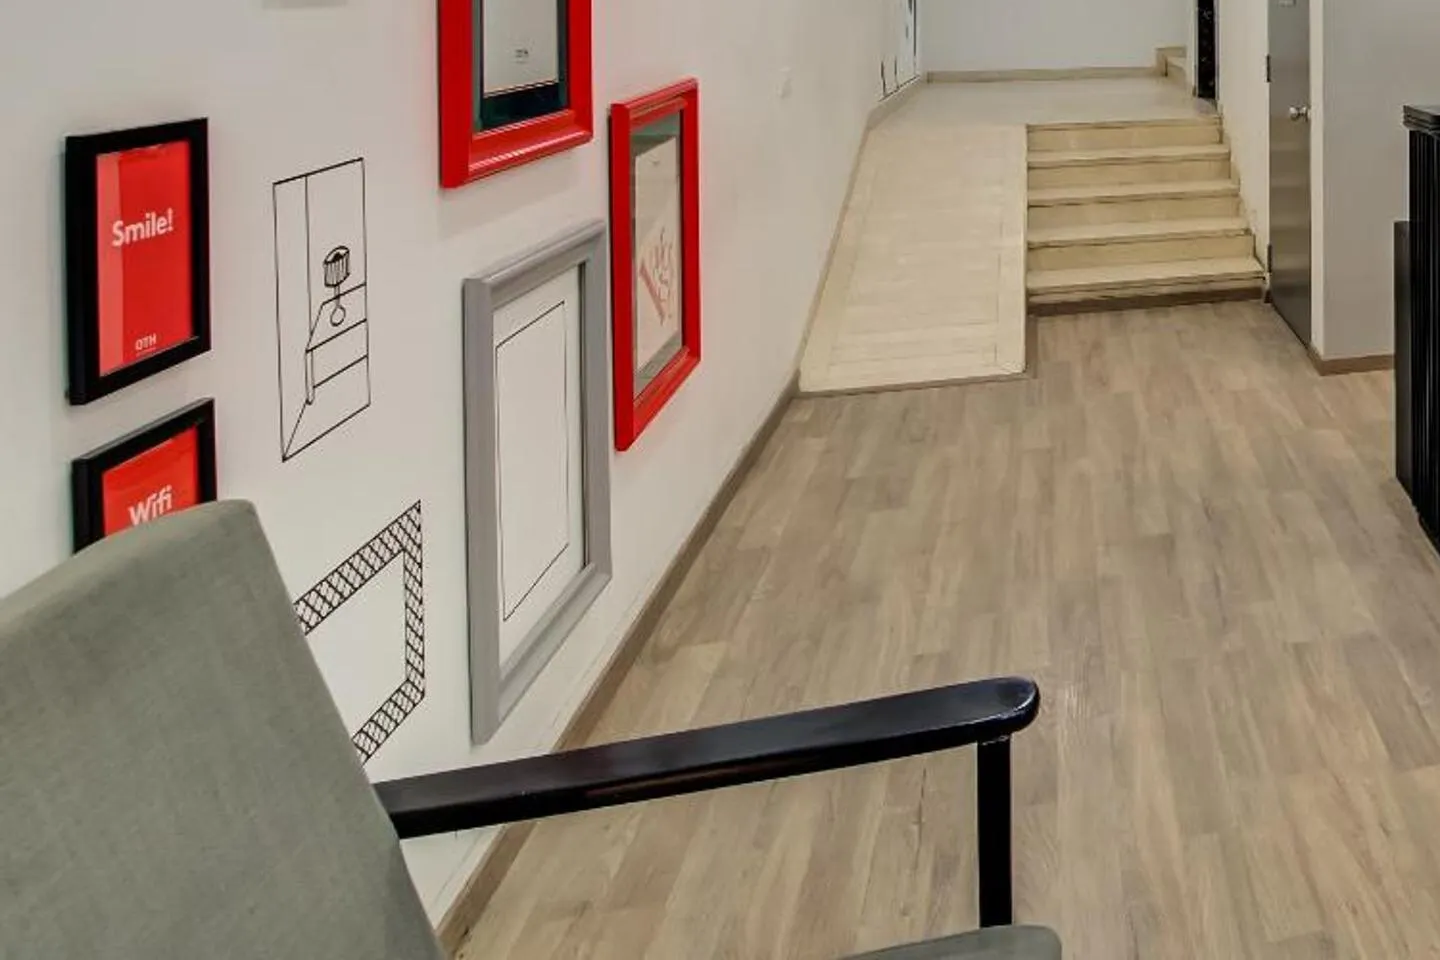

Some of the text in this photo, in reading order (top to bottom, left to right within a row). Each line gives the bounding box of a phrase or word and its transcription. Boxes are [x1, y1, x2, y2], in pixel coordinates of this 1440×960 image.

[112, 208, 174, 247] Smile!
[135, 333, 157, 351] OTH
[127, 484, 172, 526] Wifi
